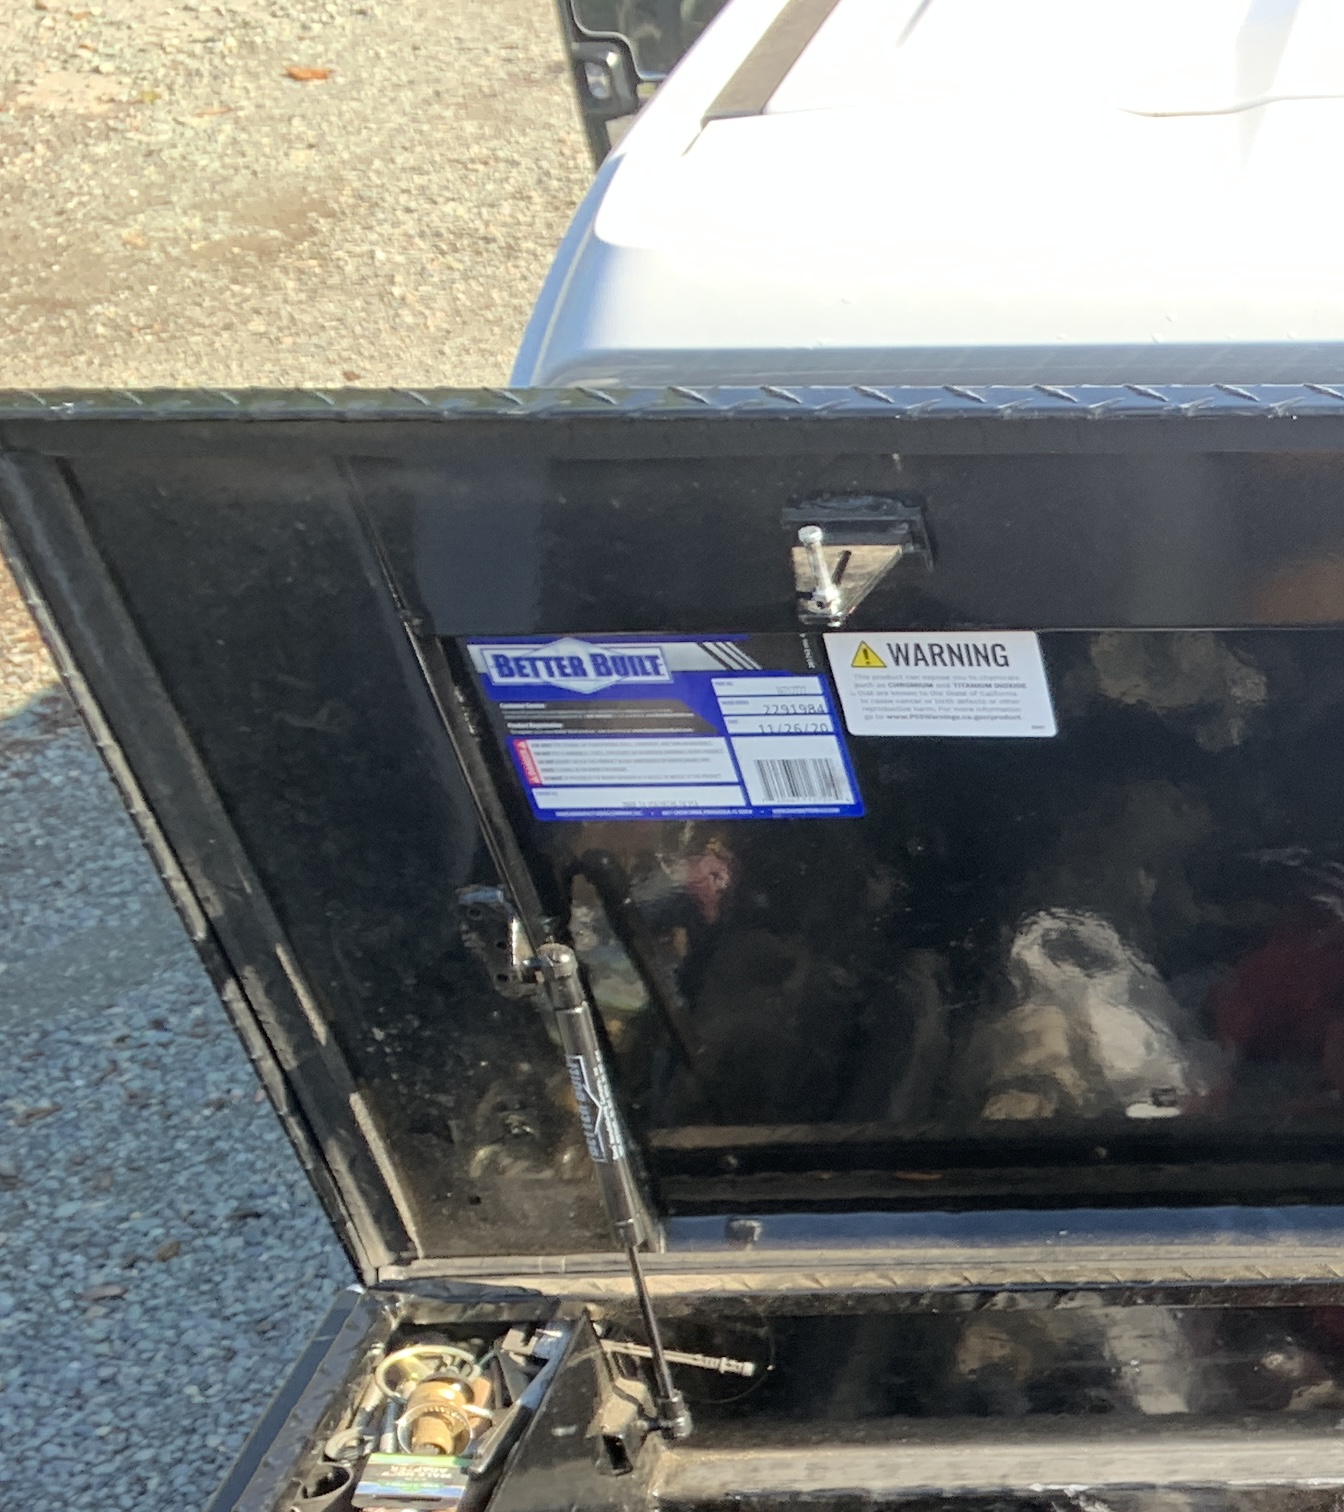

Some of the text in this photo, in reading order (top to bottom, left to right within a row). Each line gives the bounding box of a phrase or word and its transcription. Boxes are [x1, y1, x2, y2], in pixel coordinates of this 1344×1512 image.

[491, 653, 665, 678] BETTER BUILT
[886, 642, 1010, 668] WARNING
[758, 722, 830, 734] 11/26/20
